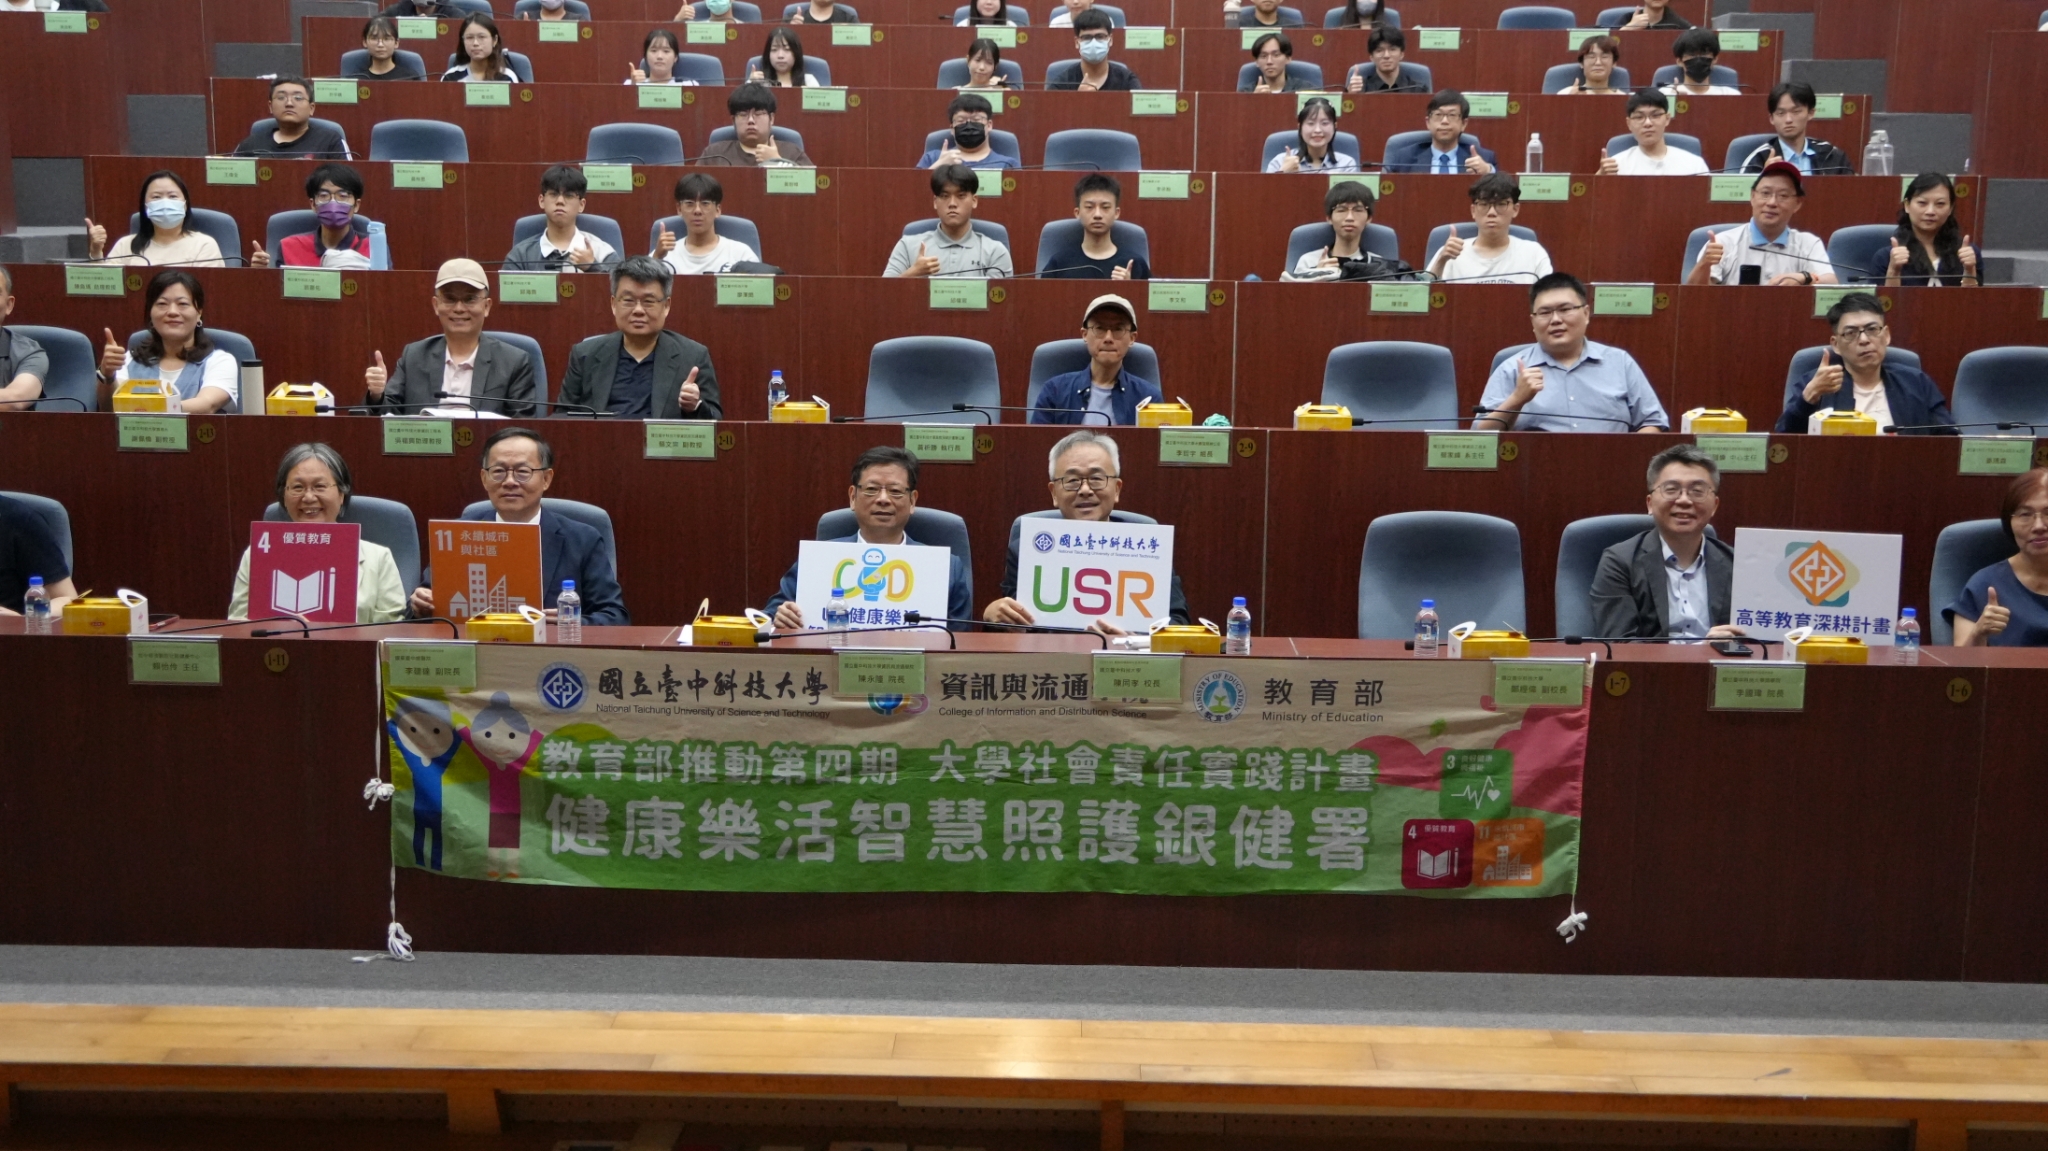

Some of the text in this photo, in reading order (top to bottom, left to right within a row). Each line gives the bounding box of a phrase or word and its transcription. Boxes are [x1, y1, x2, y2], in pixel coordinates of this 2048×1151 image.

[198, 428, 214, 438] 2-13
[457, 432, 471, 442] 2-12
[719, 435, 733, 446] 2-11
[977, 439, 992, 449] 2-10
[1239, 442, 1254, 452] 2-9
[1501, 445, 1516, 456] 2-8
[1771, 448, 1786, 458] 2-7
[257, 532, 332, 554] 4 優質教育
[435, 530, 510, 552] 11 永續城市
[1059, 532, 1160, 554] 國立臺中科技大學
[460, 544, 498, 556] 與社區
[1032, 565, 1155, 618] USR
[1736, 608, 1890, 636] 高等教育深耕計畫
[268, 654, 286, 666] 1-11
[183, 663, 200, 672] 主任
[435, 667, 461, 676] 副院長
[598, 664, 828, 705] 國立臺中科技大學
[888, 675, 906, 684] 院長
[1144, 680, 1161, 688] 校長
[1610, 677, 1626, 690] 1-7
[940, 672, 1149, 704] 資訊與流通
[1196, 676, 1210, 712] MINISTRY
[1224, 673, 1244, 712] EDUCATION
[1264, 677, 1384, 706] 教育部
[1541, 686, 1568, 694] 副校長
[1766, 689, 1784, 698] 院長
[1950, 684, 1968, 697] 1-6
[596, 704, 830, 719] National Taichung University of Science and Technology
[938, 706, 1147, 718] College of Information and Distribution Science
[1262, 712, 1384, 724] Ministry of Education
[542, 739, 1376, 792] 教育部推動第四期 大學社會責任實踐計畫
[1446, 754, 1456, 770] 3
[546, 793, 1370, 871] 健康樂活智慧照護銀健署
[1408, 824, 1456, 839] 4 優質教育
[1479, 826, 1490, 840] 11
